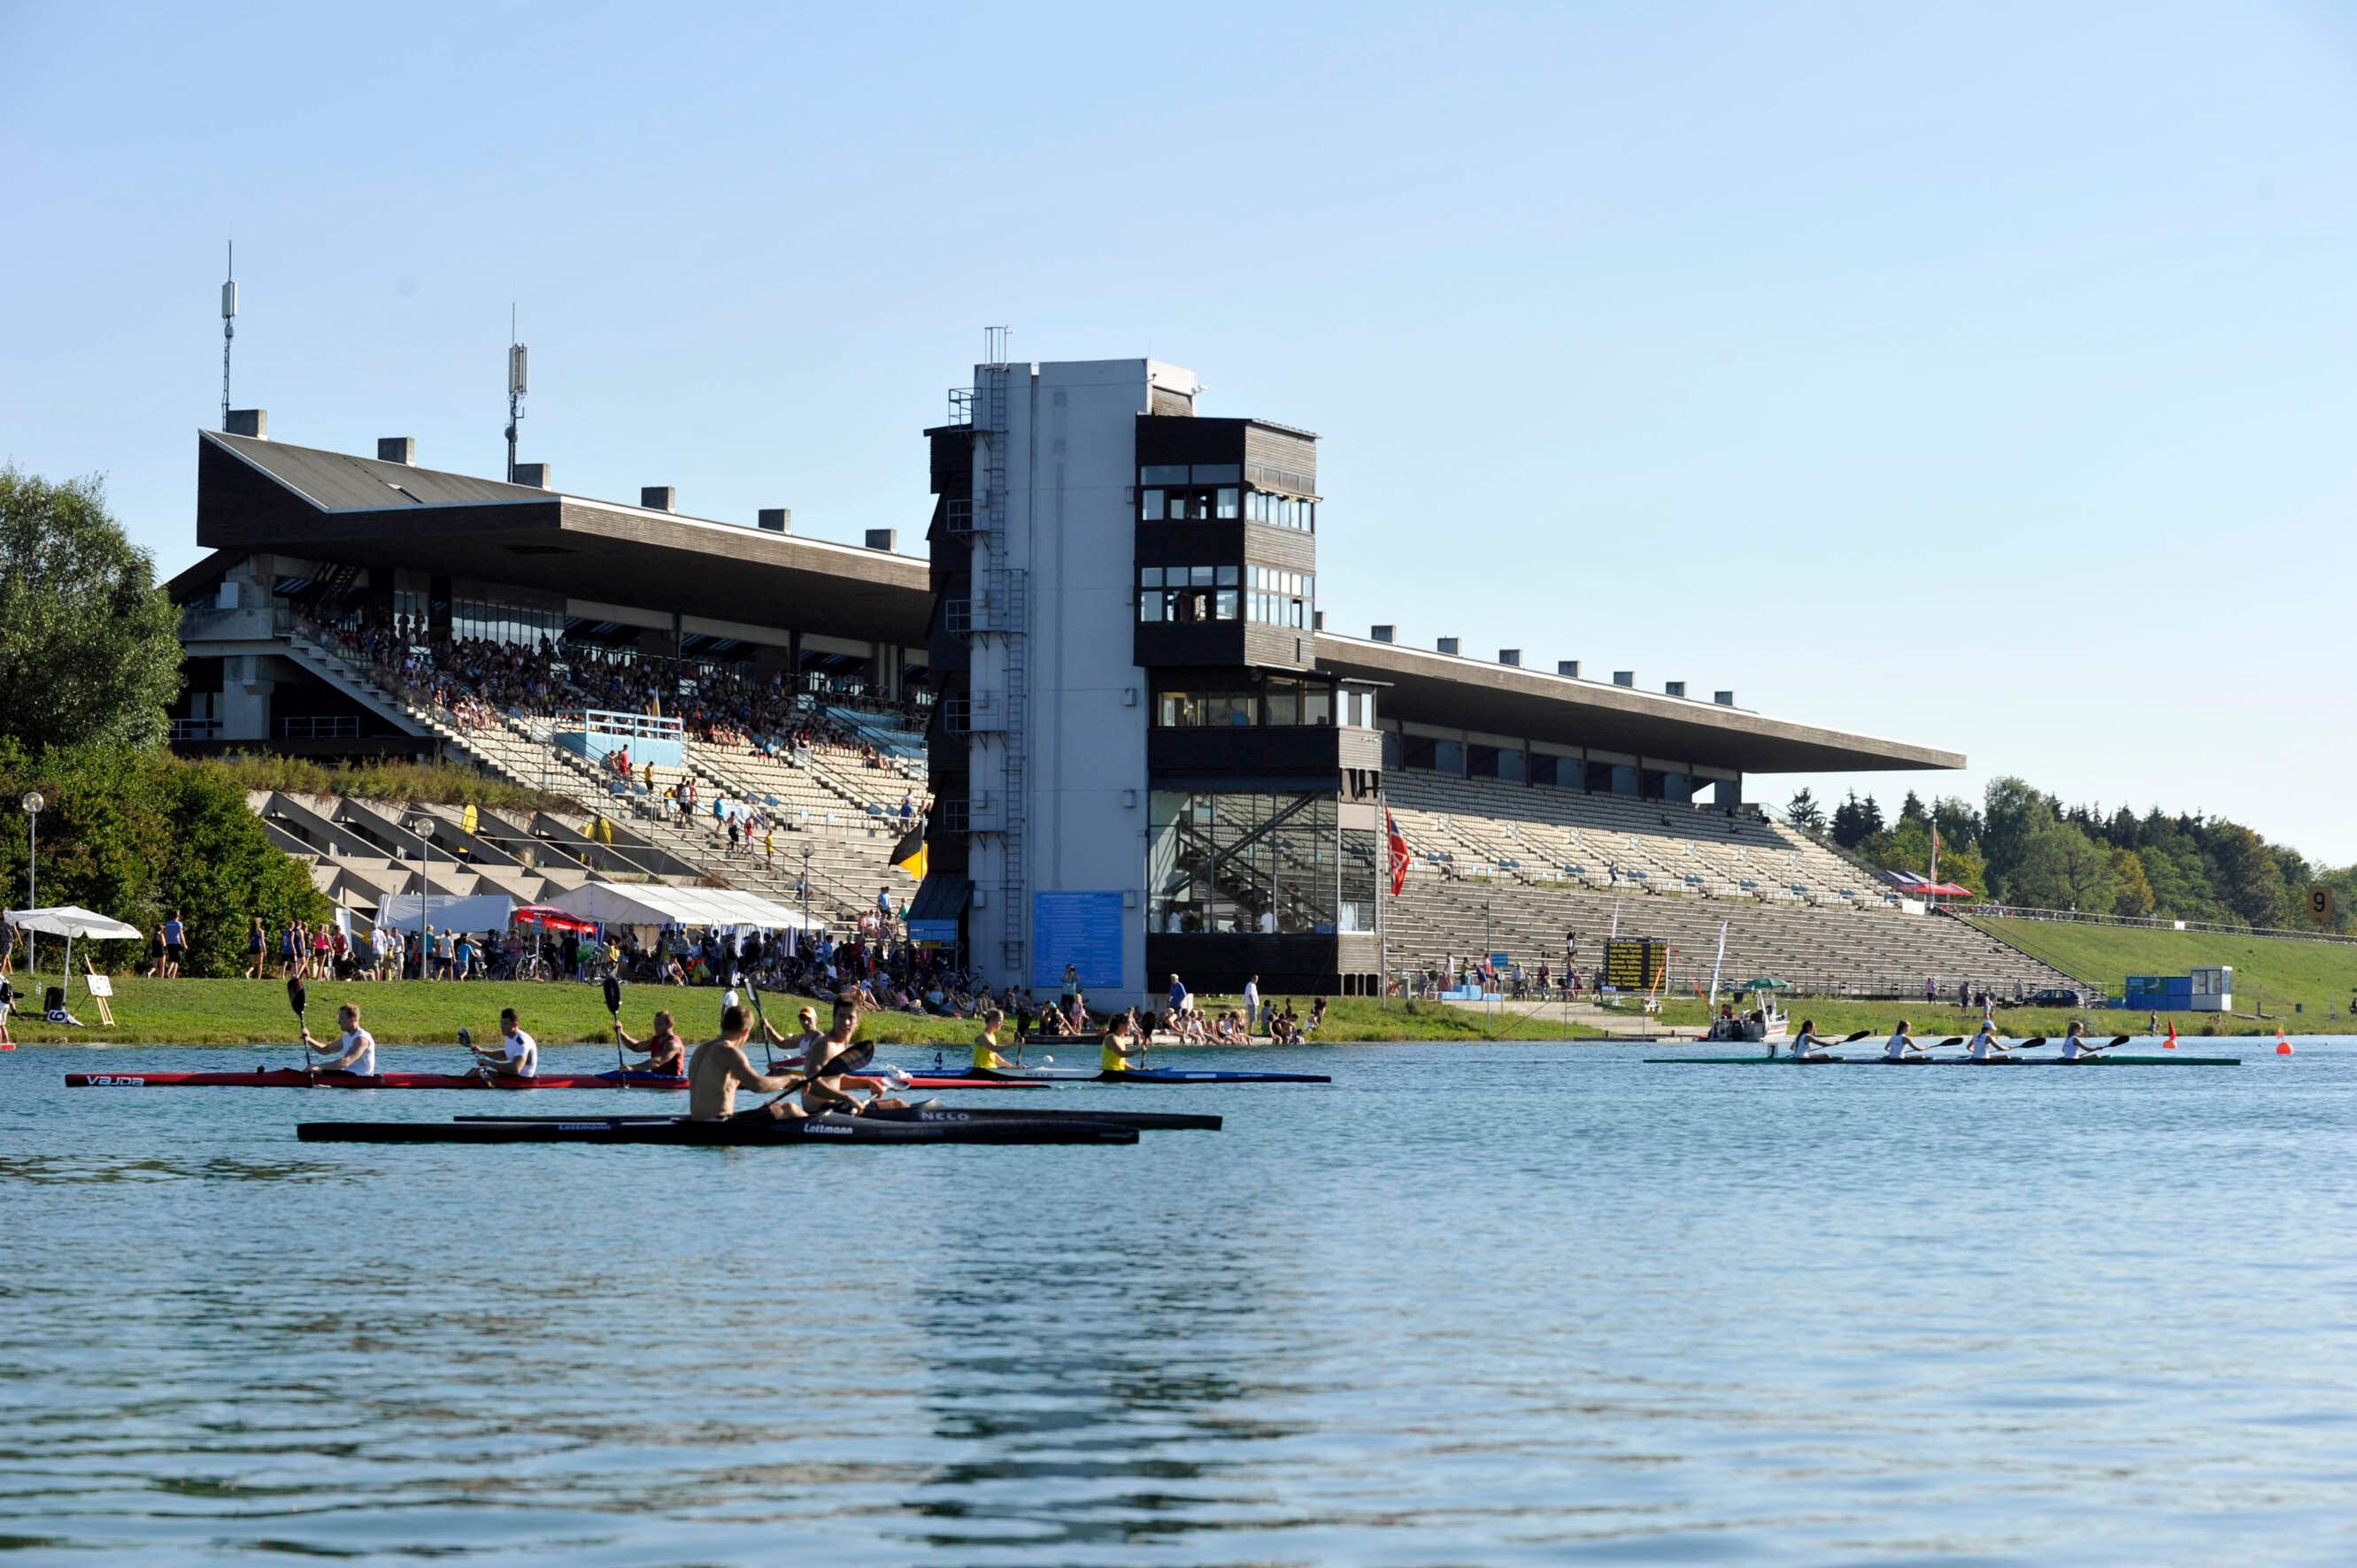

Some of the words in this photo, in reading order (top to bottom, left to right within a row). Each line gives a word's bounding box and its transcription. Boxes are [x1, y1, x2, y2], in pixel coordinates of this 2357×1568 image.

[2314, 892, 2324, 911] 9
[935, 1052, 943, 1065] 4
[920, 1111, 969, 1121] NELO
[804, 1123, 853, 1134] Lettmann
